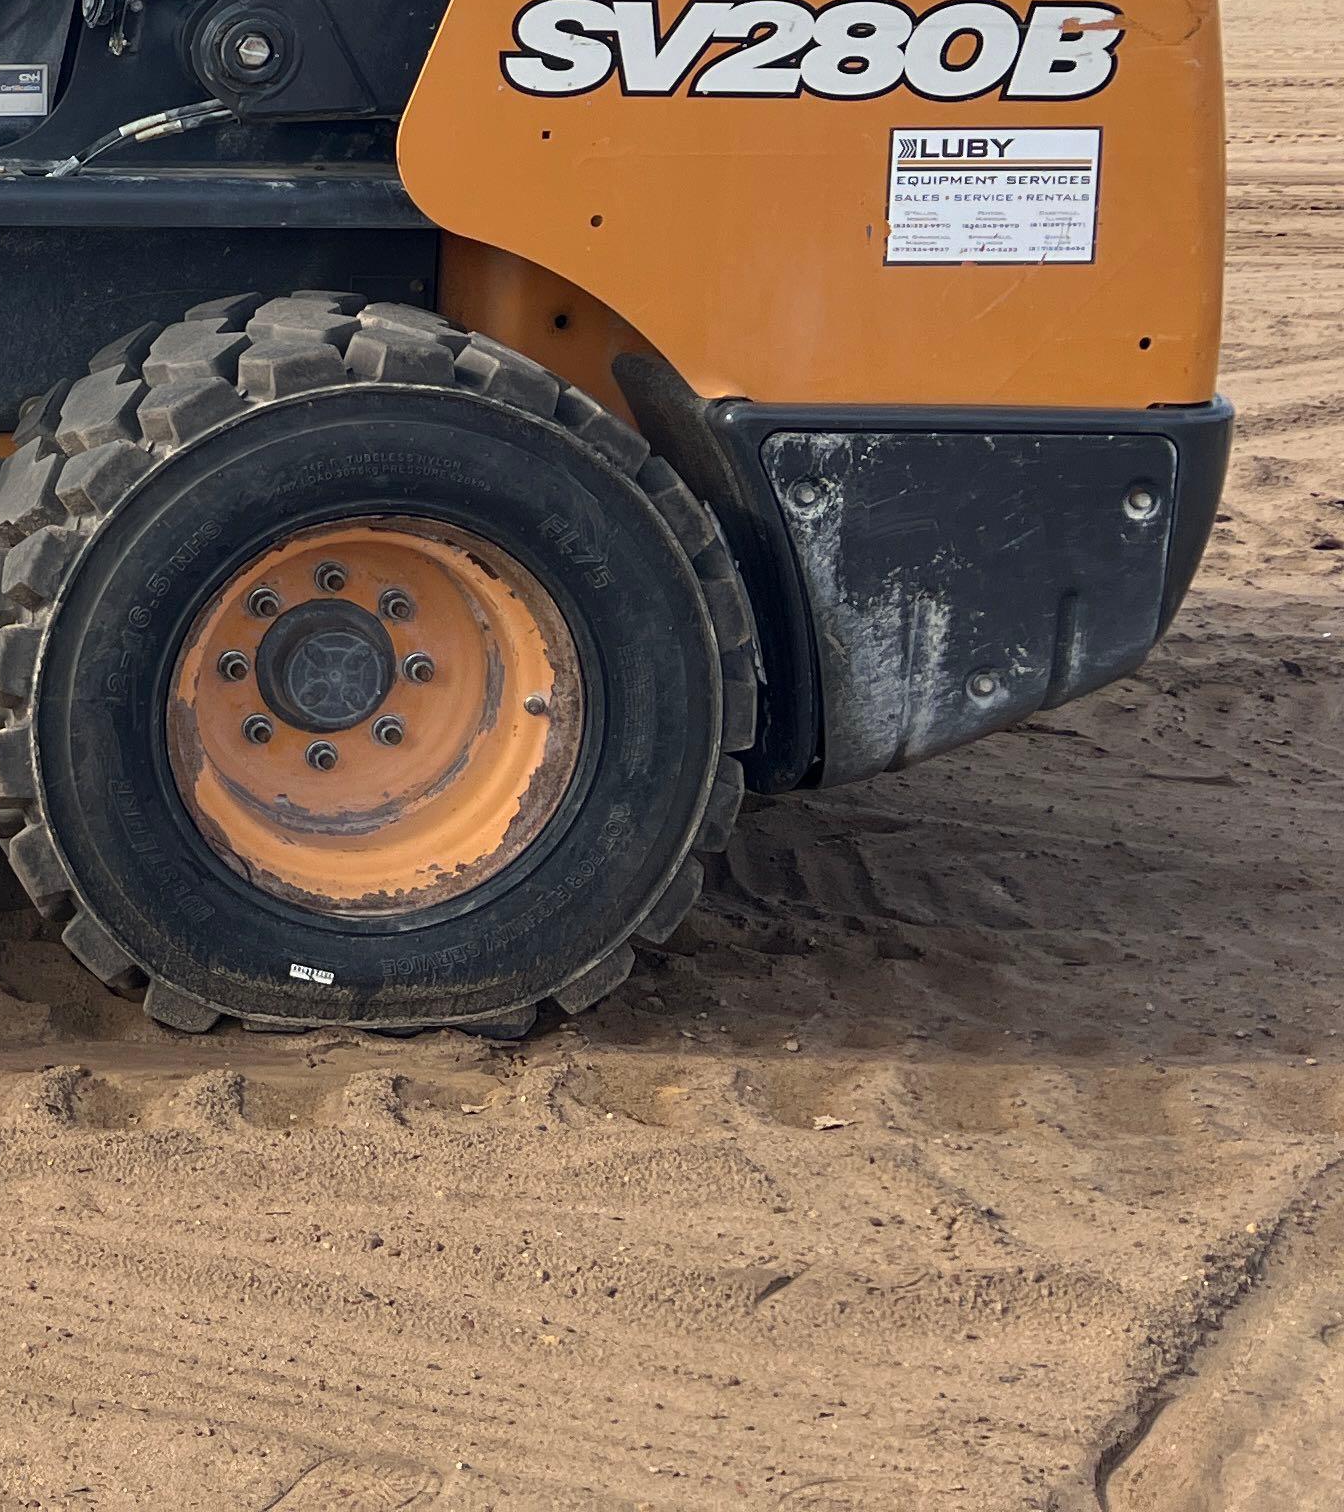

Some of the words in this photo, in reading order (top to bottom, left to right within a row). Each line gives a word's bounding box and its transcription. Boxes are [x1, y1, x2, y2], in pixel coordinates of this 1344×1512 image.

[0, 83, 40, 92] Certification
[920, 138, 1015, 158] LUBY
[896, 175, 999, 187] EQUIPMENT
[1006, 175, 1091, 185] SERVICES
[894, 193, 940, 202] SALES
[953, 193, 1014, 202] SERVICE
[1025, 193, 1090, 202] RENTALS
[347, 452, 414, 465] TUBELESS
[417, 454, 463, 470] NYLON
[169, 518, 225, 573] NHS
[563, 848, 608, 889] FOR
[377, 941, 482, 979] SERVICE
